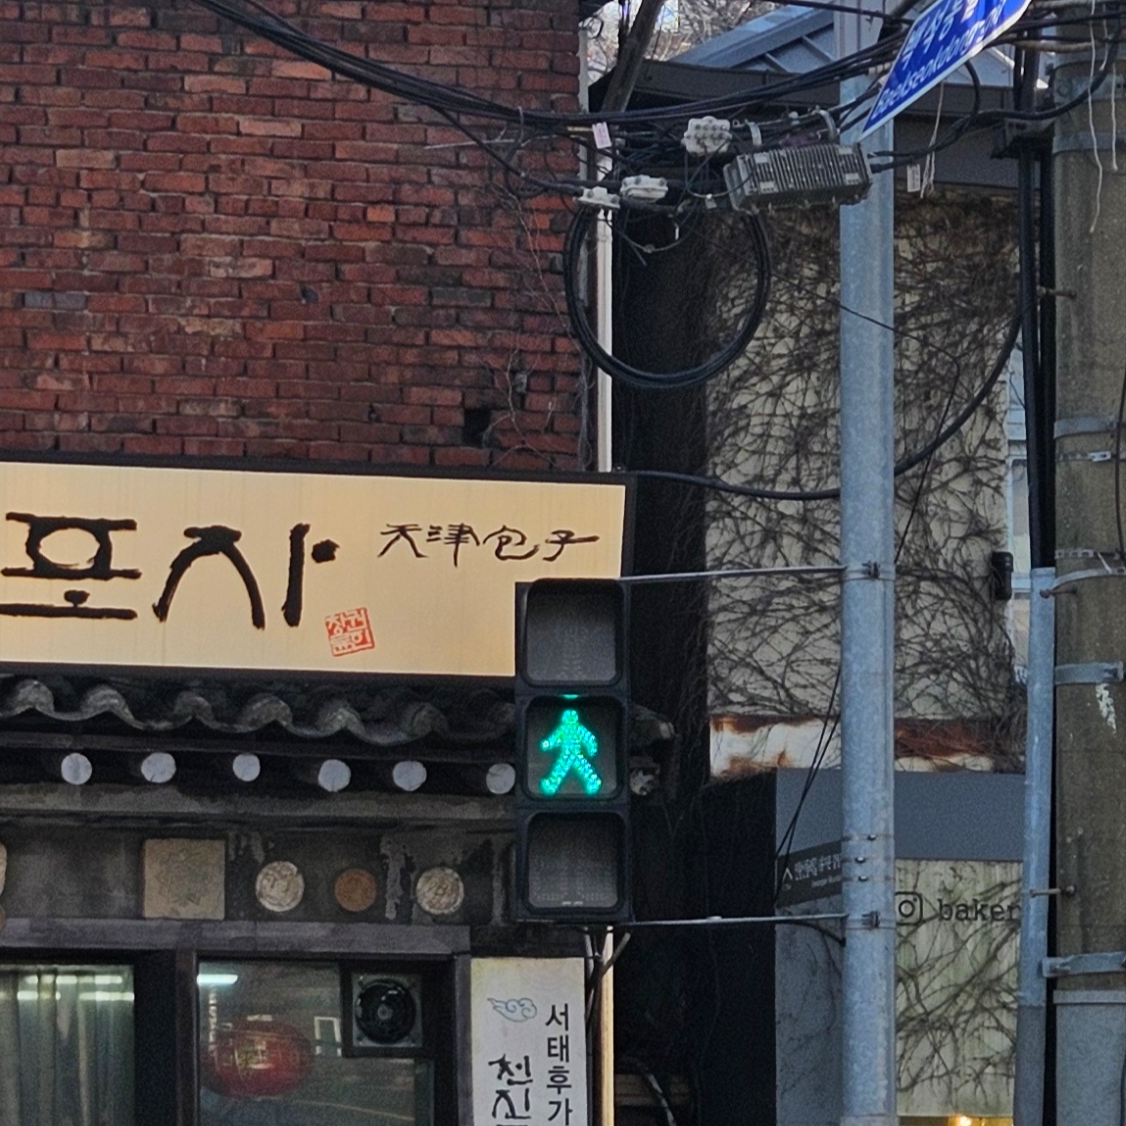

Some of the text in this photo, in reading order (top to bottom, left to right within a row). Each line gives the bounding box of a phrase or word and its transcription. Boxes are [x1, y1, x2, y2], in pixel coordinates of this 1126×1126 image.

[378, 522, 600, 567] 天津包子
[545, 1003, 573, 1126] 서태후가
